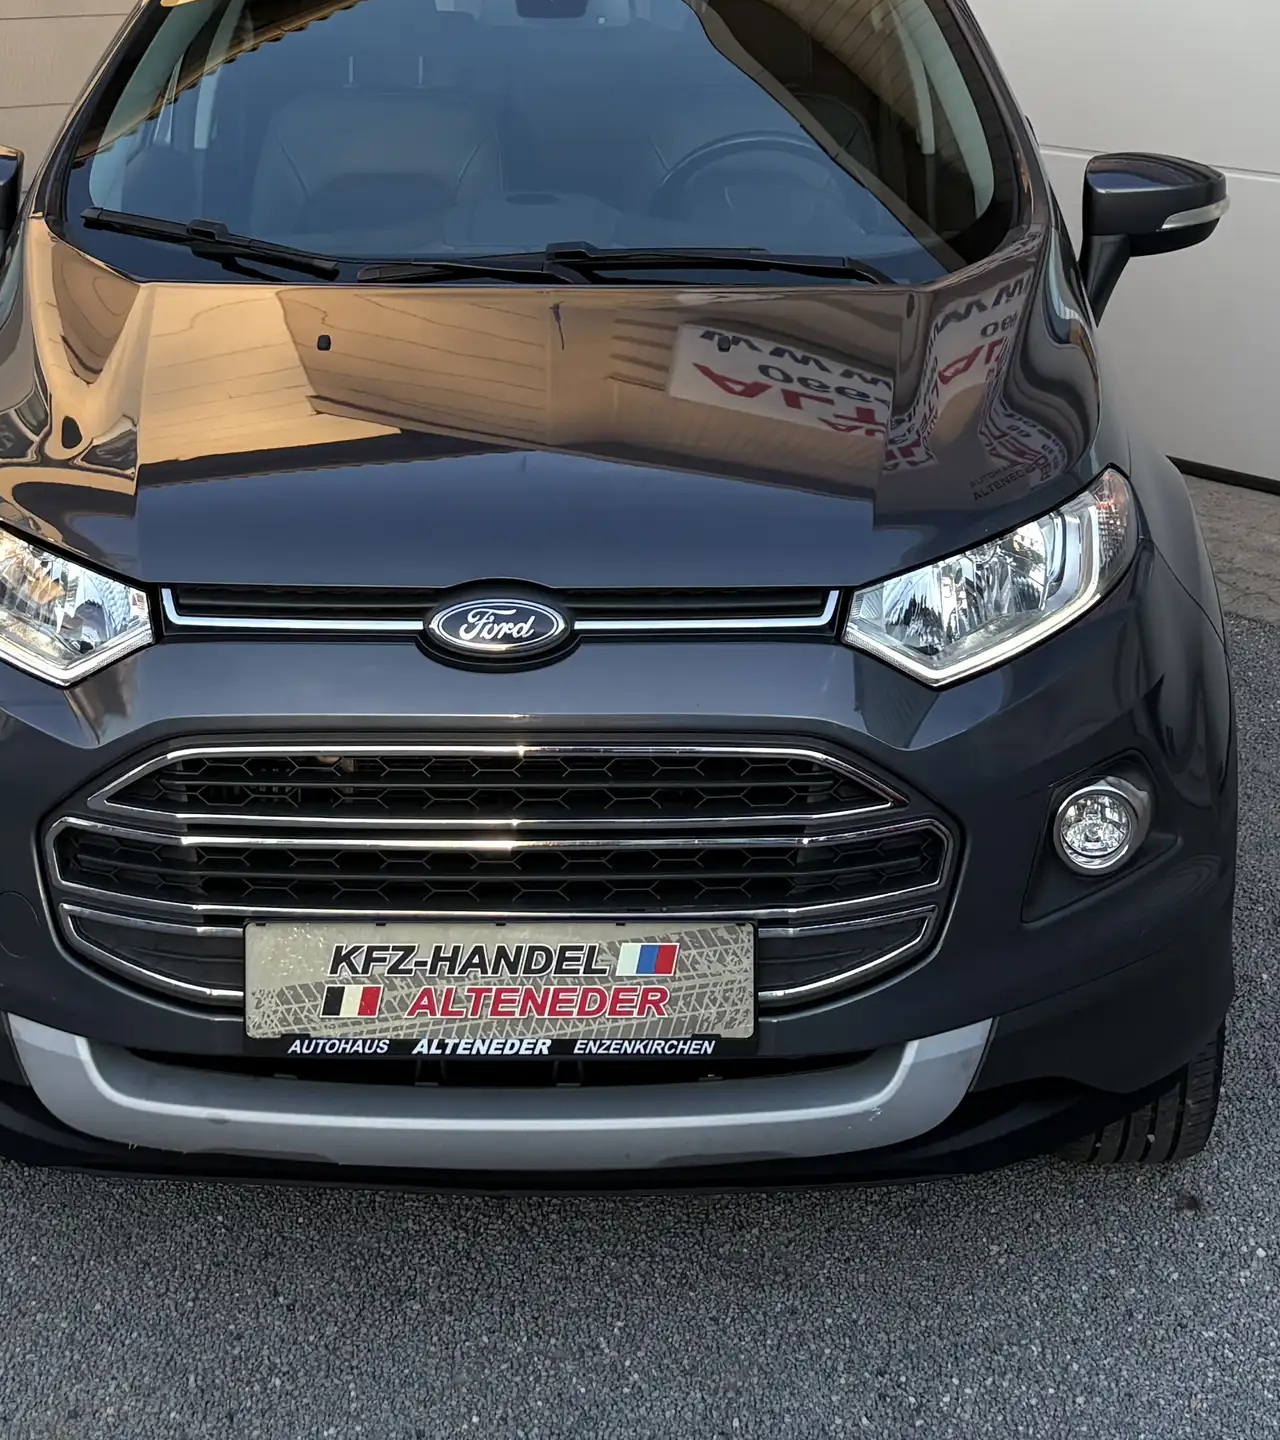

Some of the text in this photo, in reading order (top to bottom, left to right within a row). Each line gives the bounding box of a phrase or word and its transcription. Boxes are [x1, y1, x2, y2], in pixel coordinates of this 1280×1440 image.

[458, 607, 536, 641] Ford
[328, 944, 609, 976] KFZ-HANDEL
[406, 985, 670, 1018] ALTENEDER
[287, 1038, 716, 1056] AUTOHAUS ALTENEDER ENZENKIRCHEN
